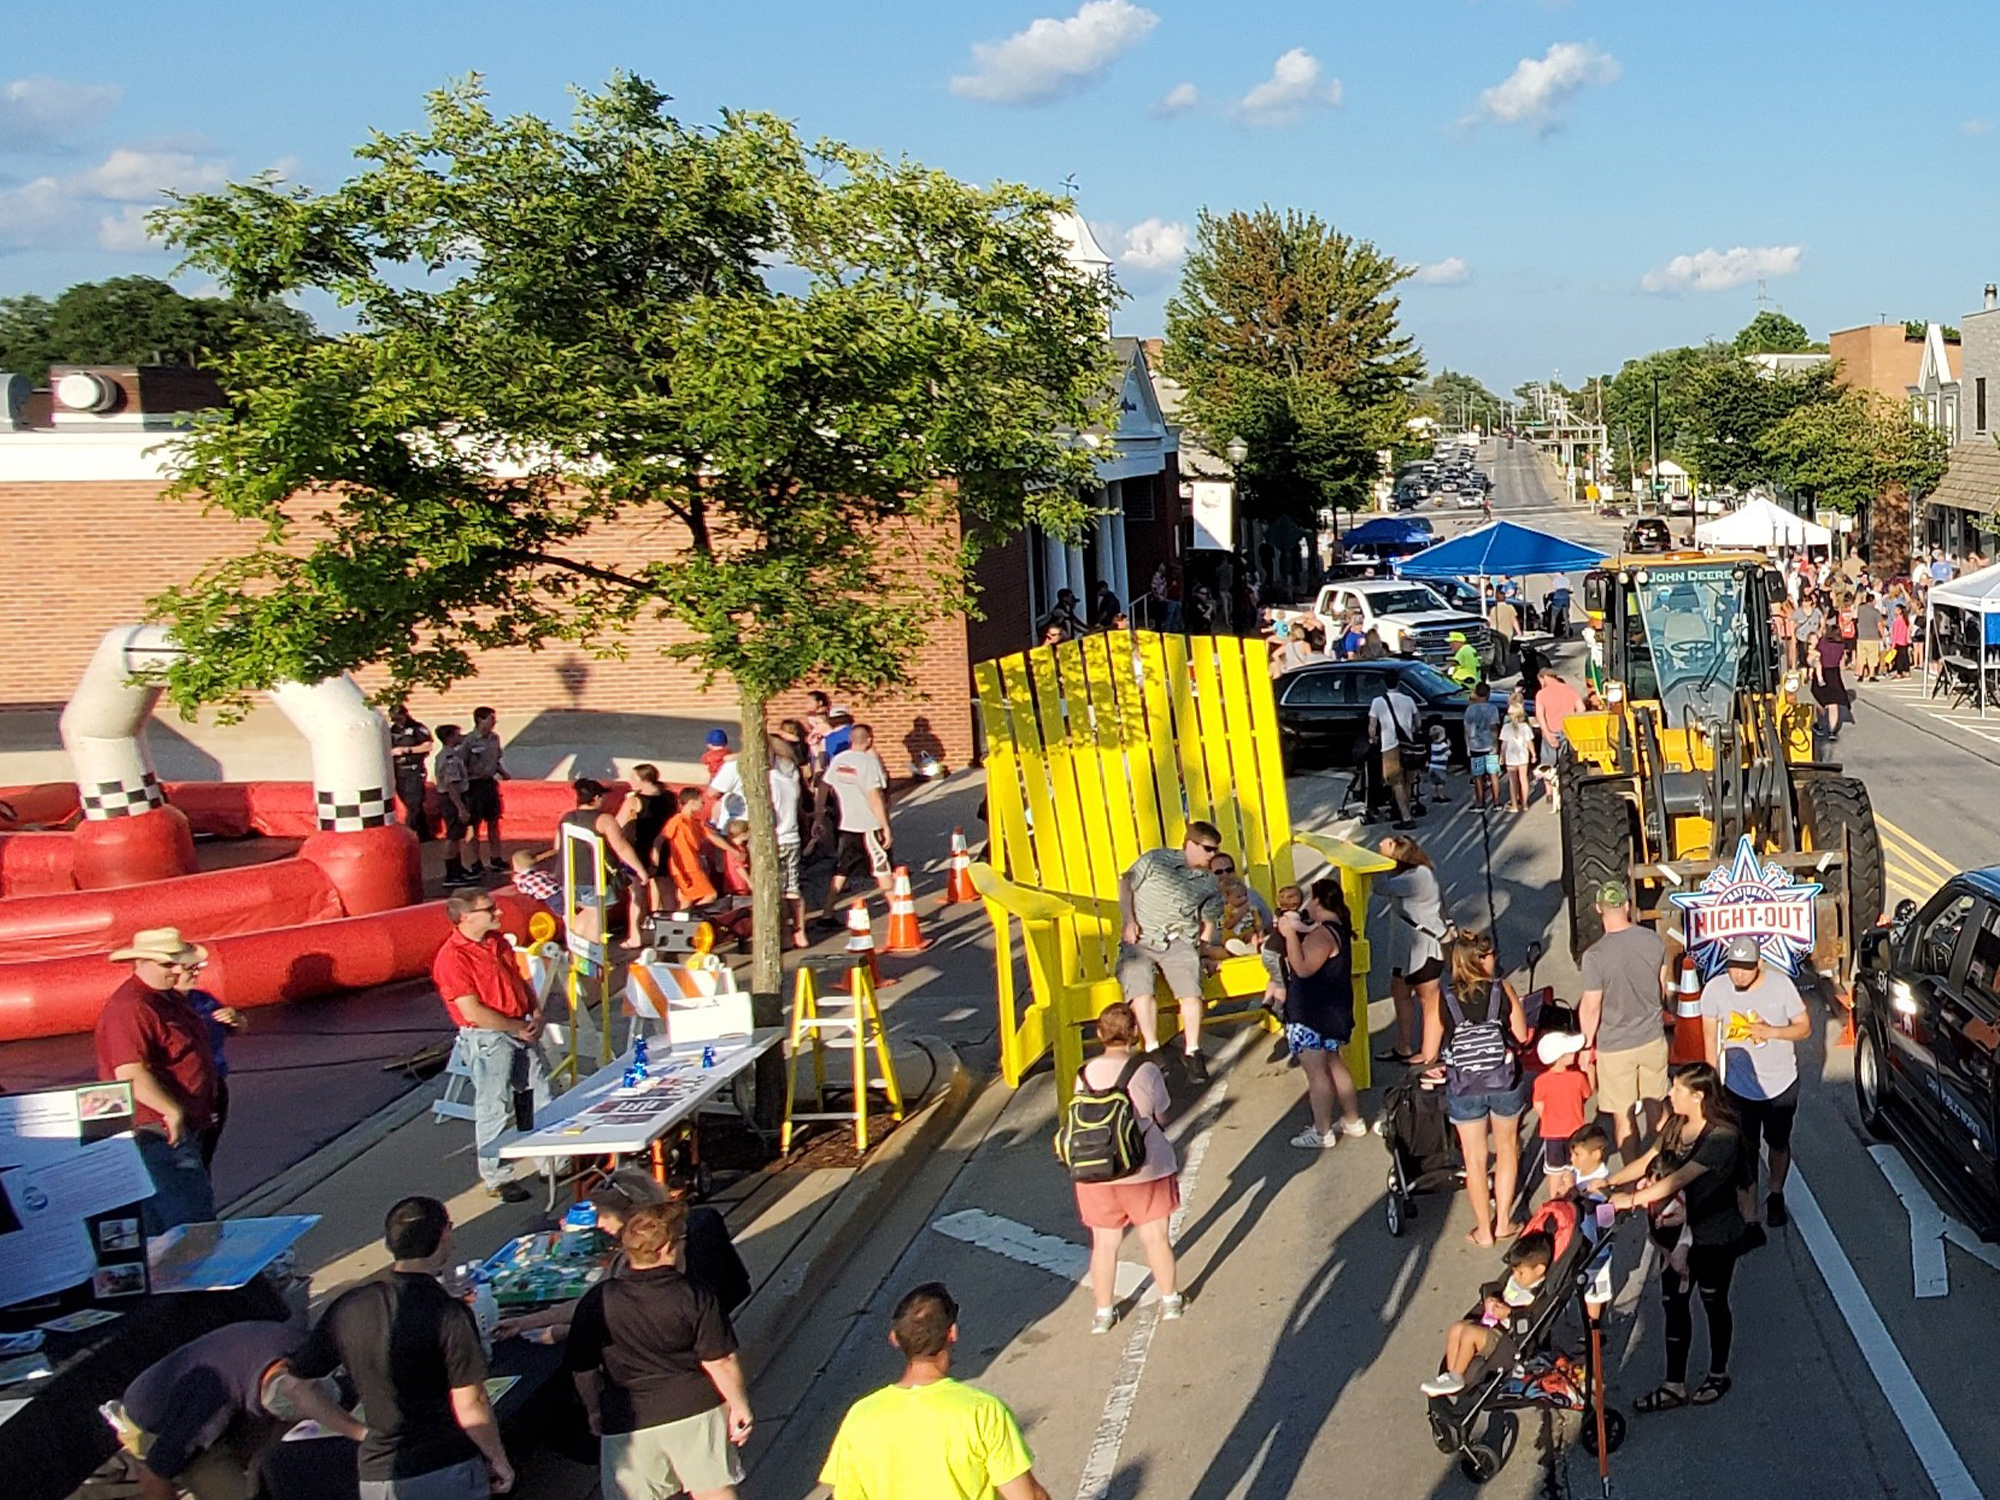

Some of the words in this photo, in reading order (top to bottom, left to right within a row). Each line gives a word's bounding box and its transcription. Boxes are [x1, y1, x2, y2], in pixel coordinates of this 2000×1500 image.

[1648, 571, 1685, 583] JOHN
[1687, 569, 1733, 581] DEERE
[1726, 886, 1768, 902] NATIONAL
[1694, 907, 1758, 938] NIGHT
[1764, 906, 1804, 932] OUT
